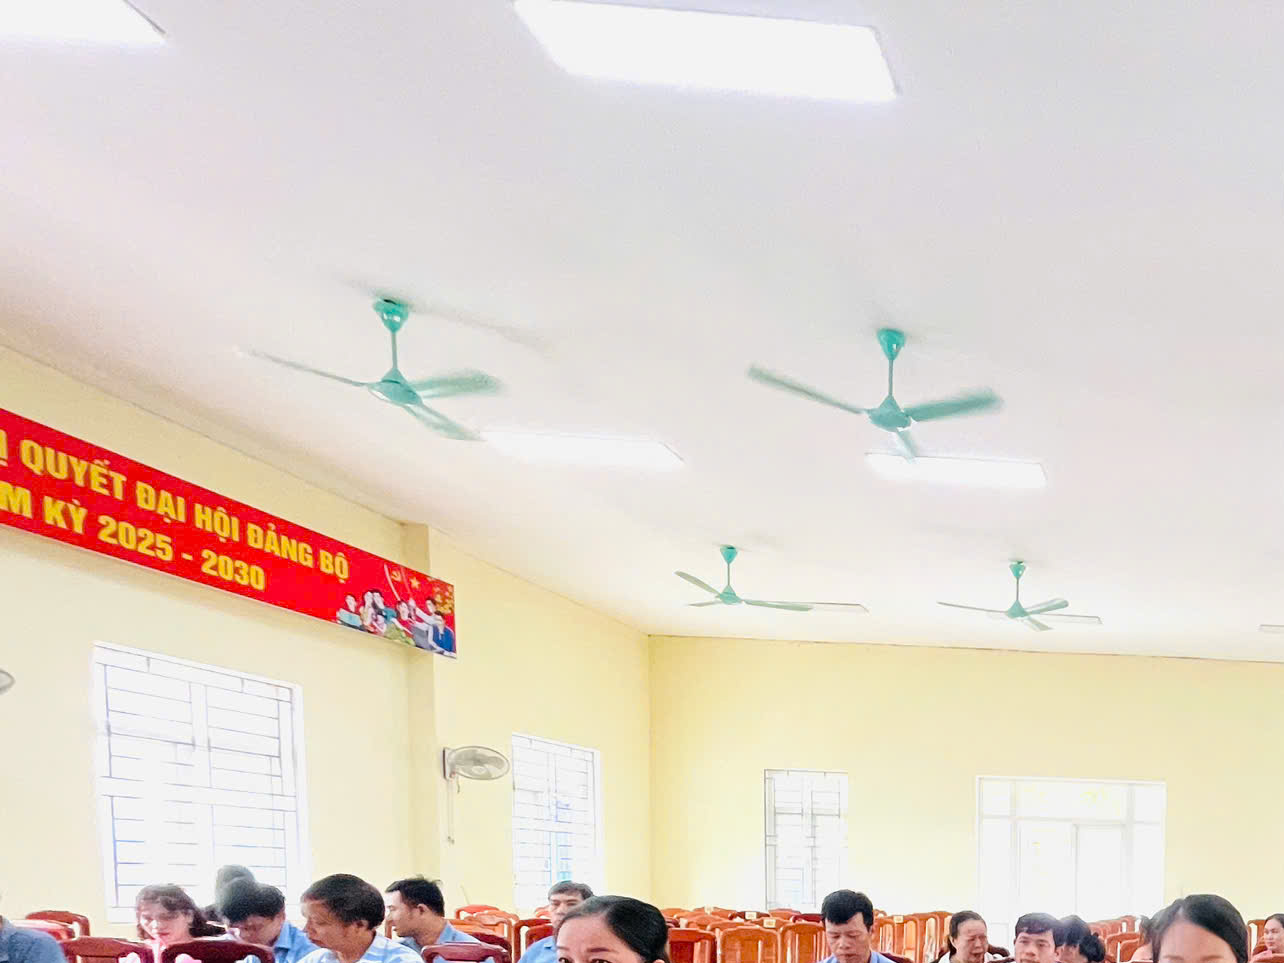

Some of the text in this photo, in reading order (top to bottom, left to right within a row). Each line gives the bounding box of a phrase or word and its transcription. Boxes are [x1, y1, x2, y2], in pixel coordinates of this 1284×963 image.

[20, 438, 128, 501] QUYẾT
[135, 480, 187, 524] ĐẠI
[194, 502, 240, 543] HỘI
[246, 522, 315, 569] ĐẢNG
[319, 548, 350, 585] BỘ
[42, 494, 88, 535] KỲ
[97, 514, 174, 562] 2025
[181, 551, 194, 561] -
[200, 548, 266, 593] 2030
